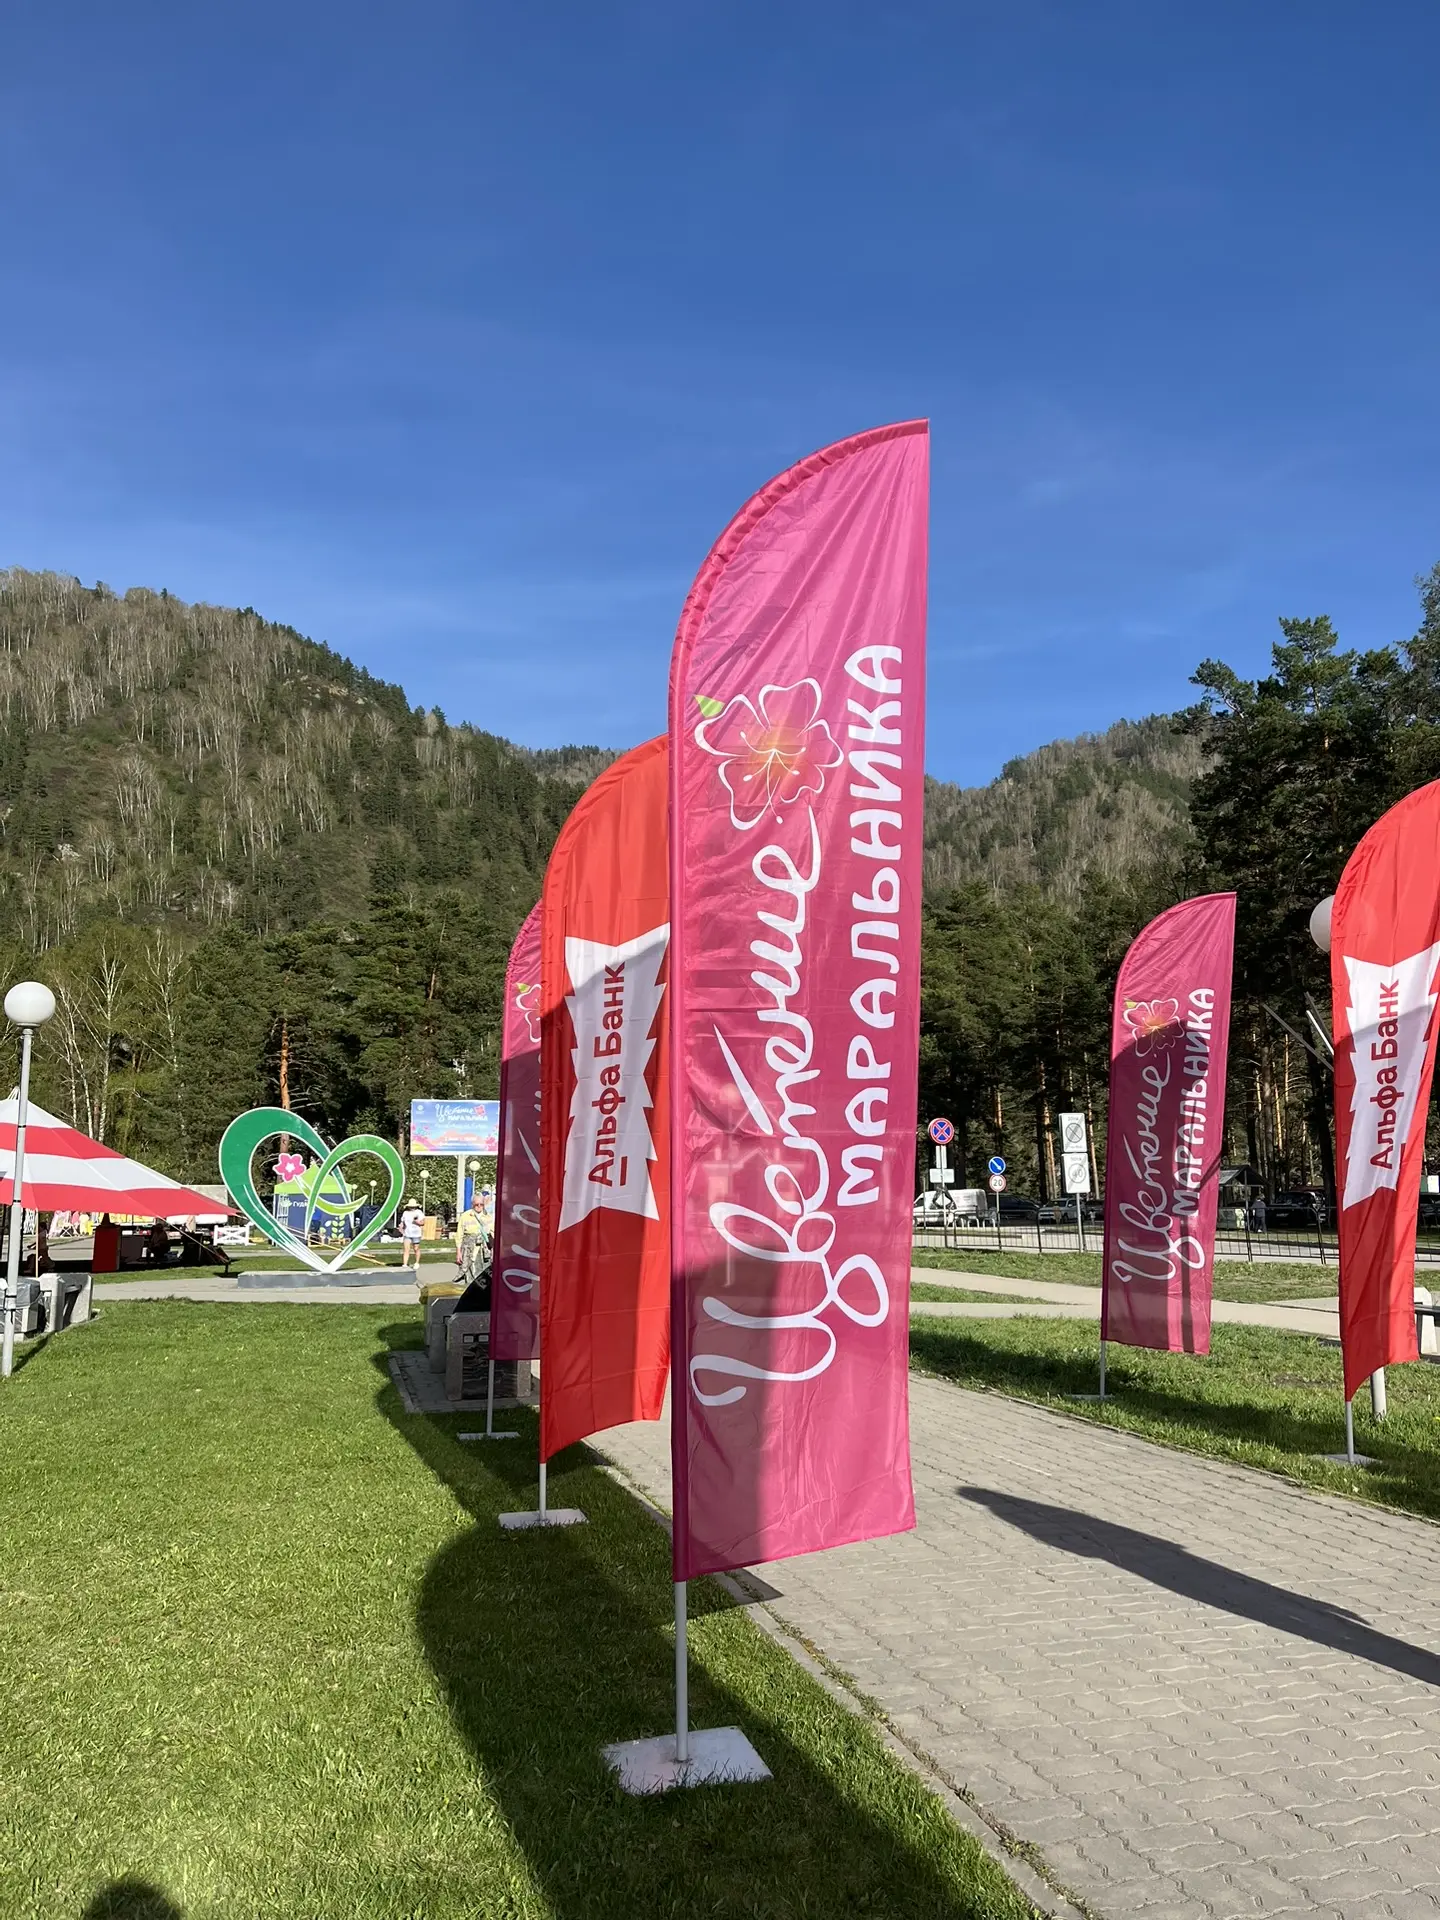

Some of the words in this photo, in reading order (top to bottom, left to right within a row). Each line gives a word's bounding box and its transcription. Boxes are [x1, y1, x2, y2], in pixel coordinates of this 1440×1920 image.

[594, 961, 626, 1058] Банк
[837, 644, 902, 1207] МАРАЛЬНИКА
[690, 805, 889, 1406] Цветение
[1172, 988, 1214, 1217] МАРАЛЬНИКА
[1371, 979, 1400, 1061] Банк
[588, 1064, 627, 1187] Альфа
[1112, 1052, 1205, 1282] Цветение
[1370, 1065, 1404, 1170] Альфа
